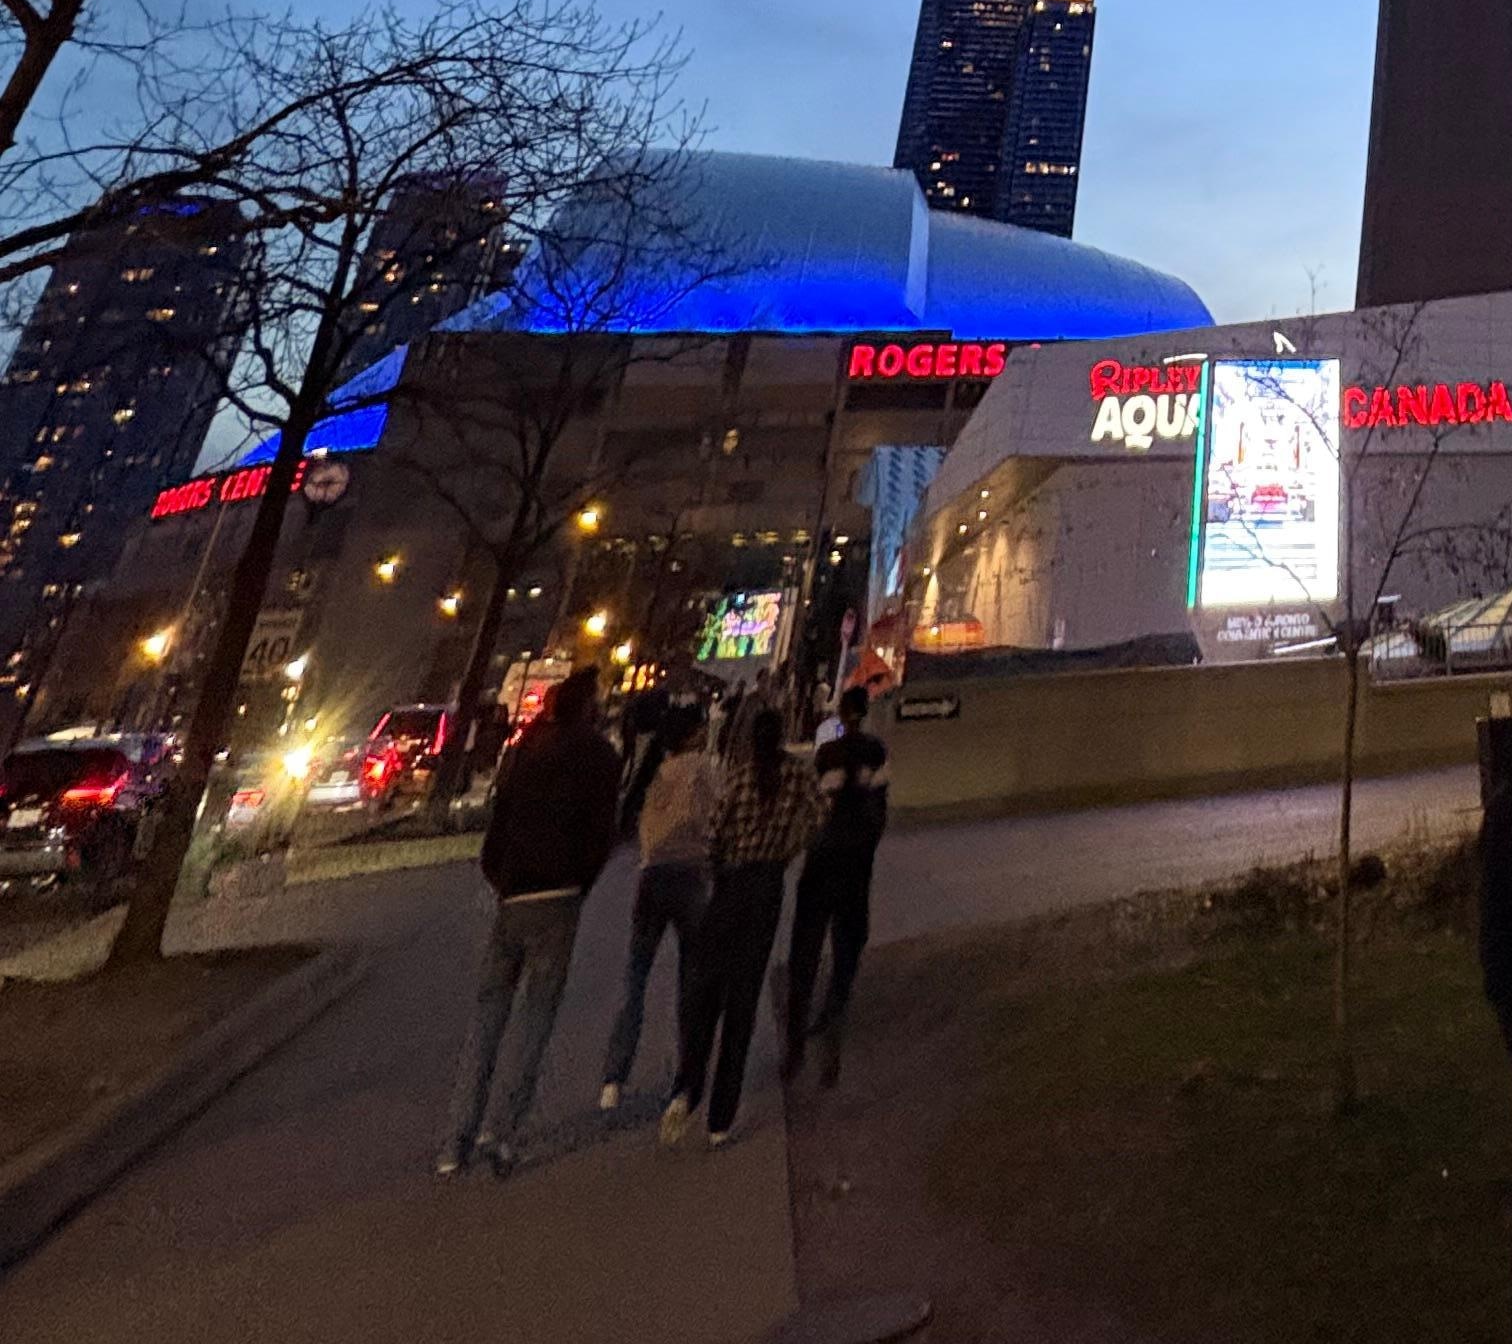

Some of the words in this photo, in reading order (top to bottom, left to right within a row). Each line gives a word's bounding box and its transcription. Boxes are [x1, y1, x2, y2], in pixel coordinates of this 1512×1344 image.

[850, 344, 1005, 377] ROGERS
[151, 478, 216, 519] ROGERS
[220, 460, 305, 502] CENT
[248, 636, 291, 666] 40
